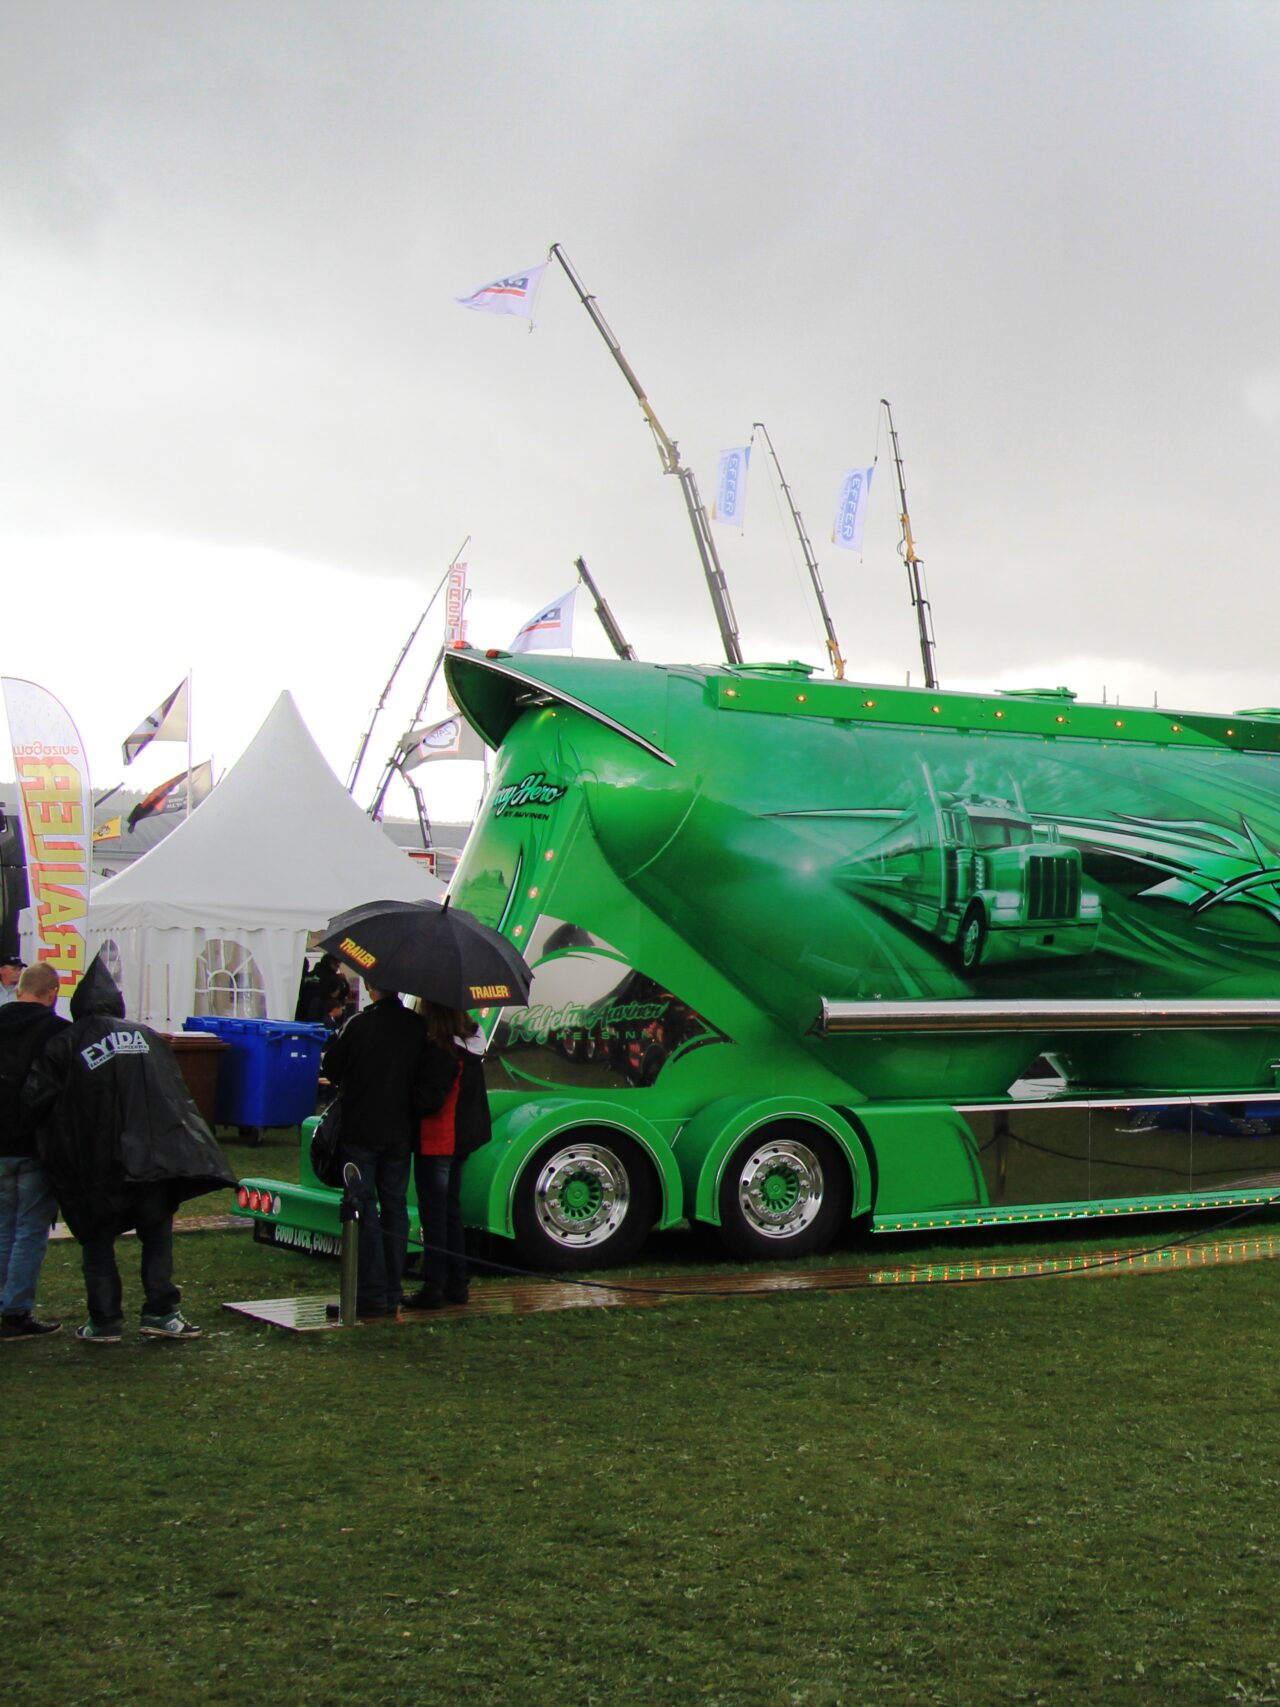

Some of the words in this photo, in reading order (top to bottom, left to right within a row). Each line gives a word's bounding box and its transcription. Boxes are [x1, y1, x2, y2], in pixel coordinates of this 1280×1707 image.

[844, 477, 861, 539] EFFER
[339, 937, 377, 970] TRAILER
[470, 985, 511, 1000] TRAILER
[275, 1224, 294, 1244] GOOD
[313, 1232, 334, 1254] GOOD
